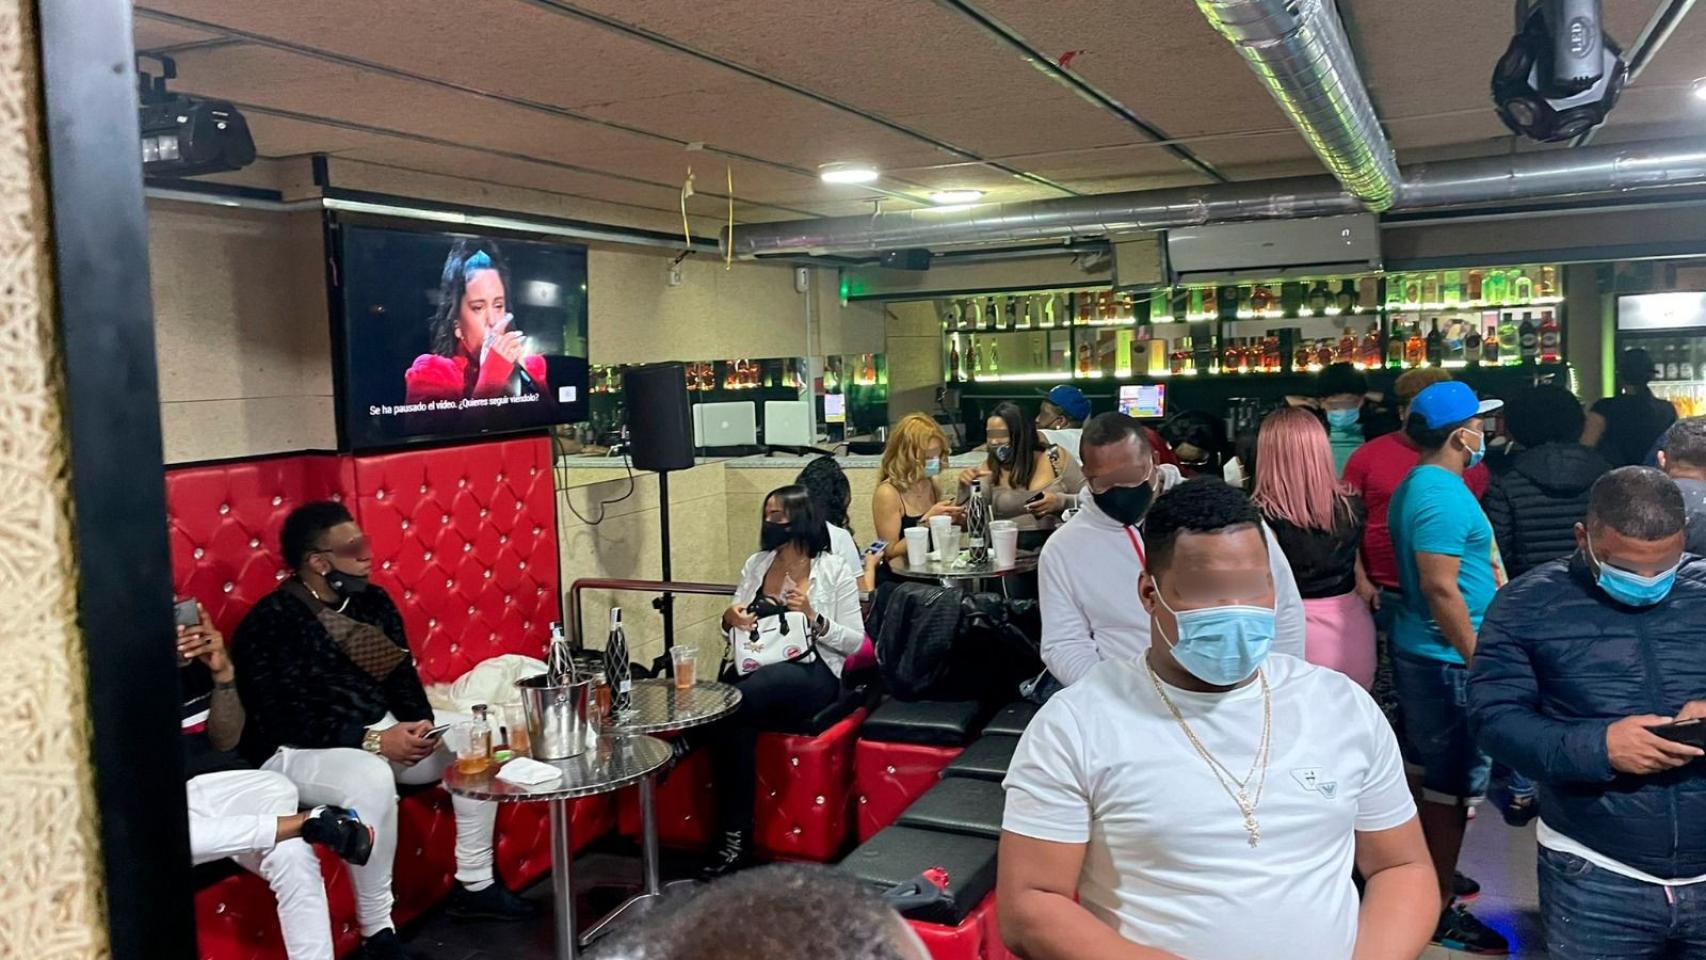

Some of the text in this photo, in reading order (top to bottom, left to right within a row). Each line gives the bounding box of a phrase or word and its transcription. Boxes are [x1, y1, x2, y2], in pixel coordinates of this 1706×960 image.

[1571, 22, 1582, 52] LED
[369, 405, 380, 415] Se
[382, 404, 392, 414] ha
[393, 401, 427, 416] pausado
[428, 400, 435, 410] el
[489, 396, 509, 406] seguir
